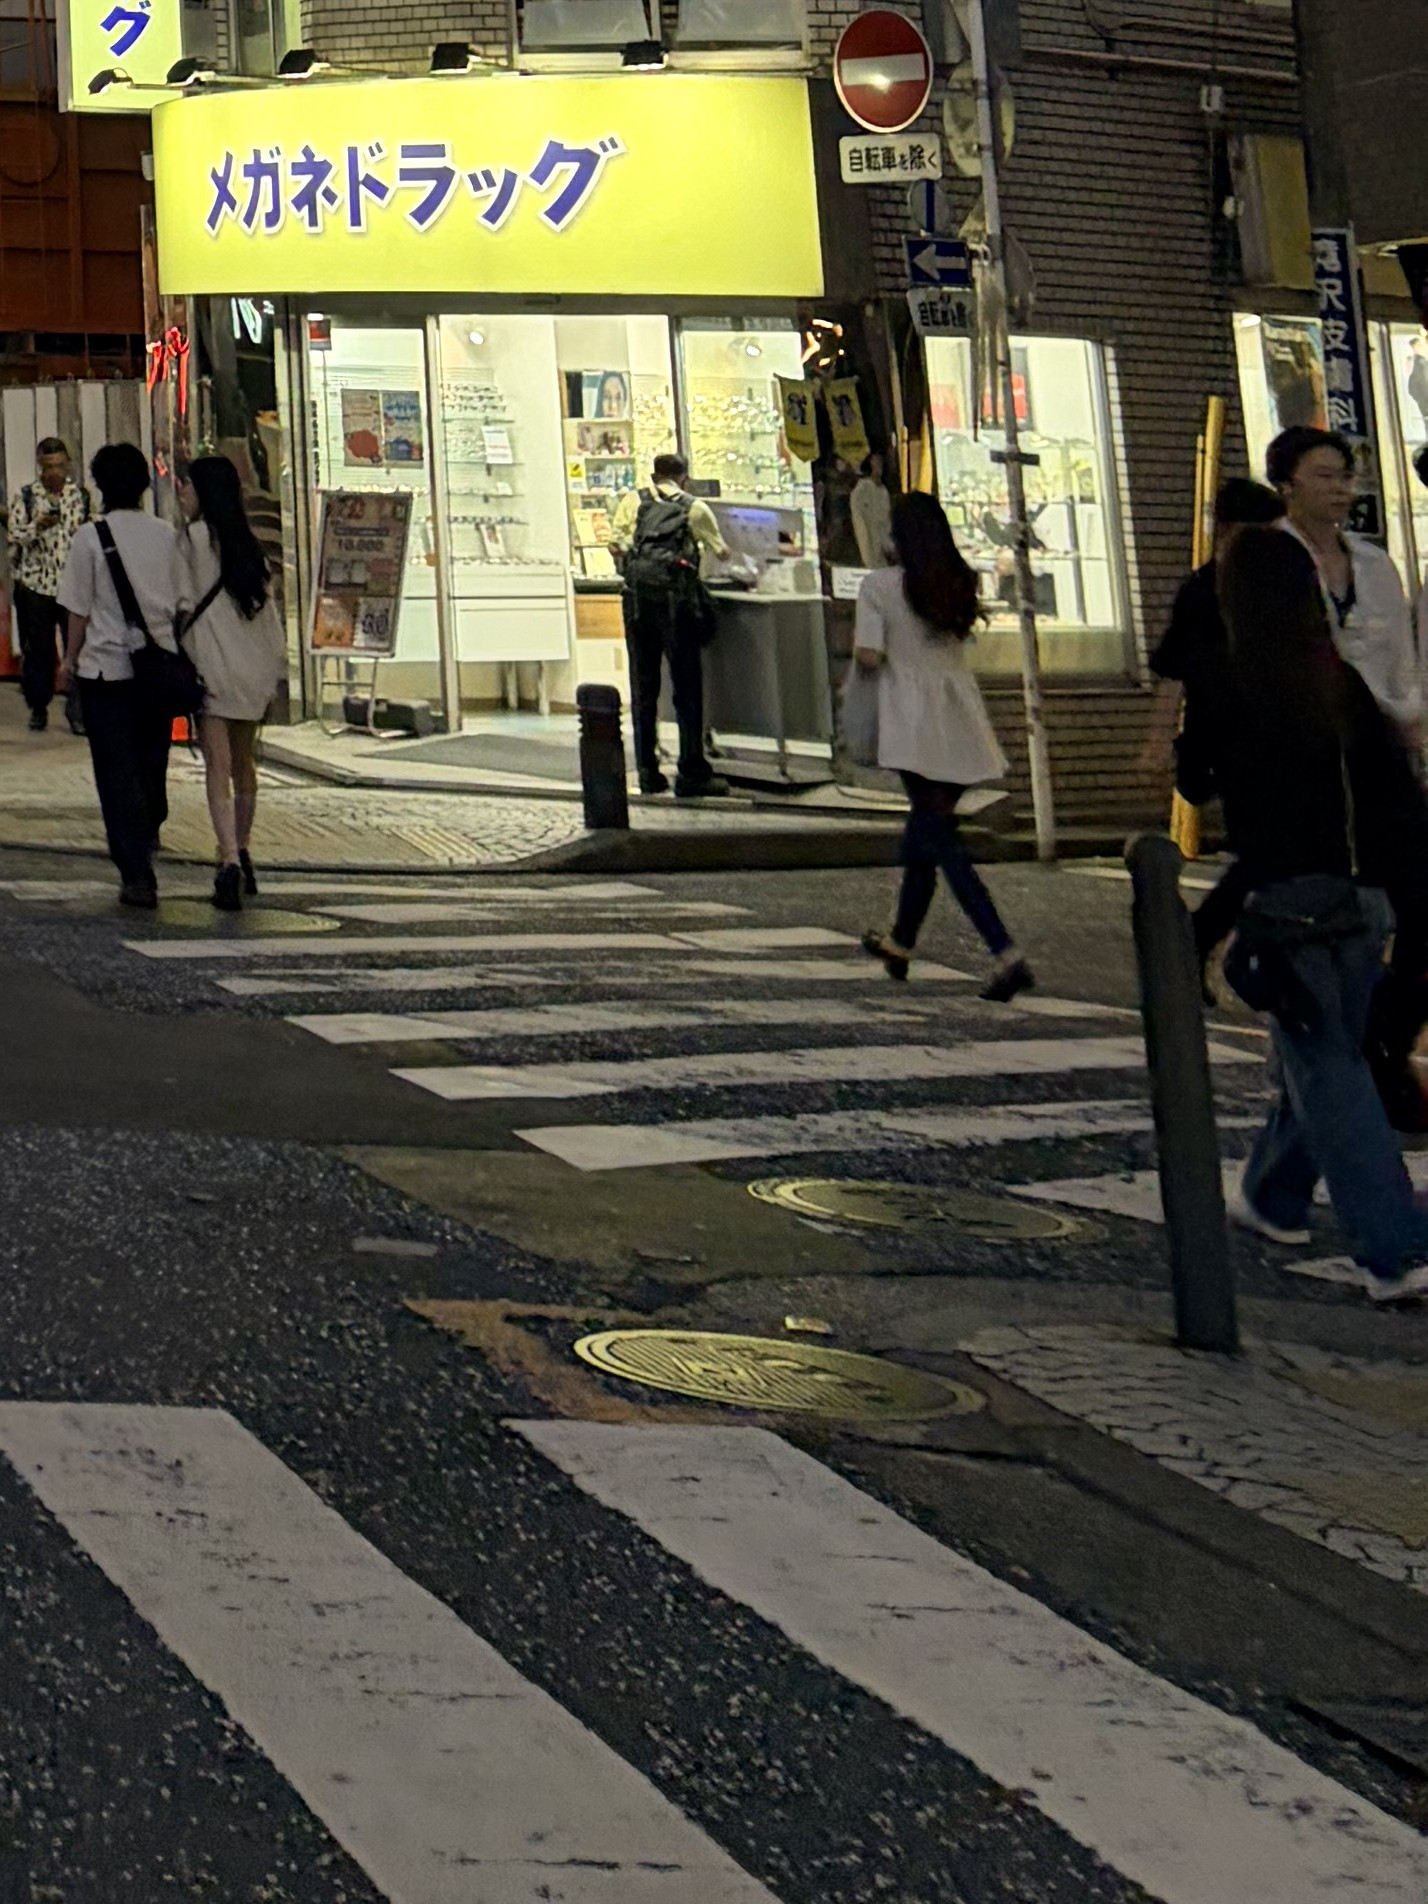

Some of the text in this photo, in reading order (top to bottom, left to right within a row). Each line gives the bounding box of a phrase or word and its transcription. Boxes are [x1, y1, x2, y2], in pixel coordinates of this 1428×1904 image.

[205, 134, 624, 234] メガネドラッグ
[849, 144, 938, 173] 自転車を除く
